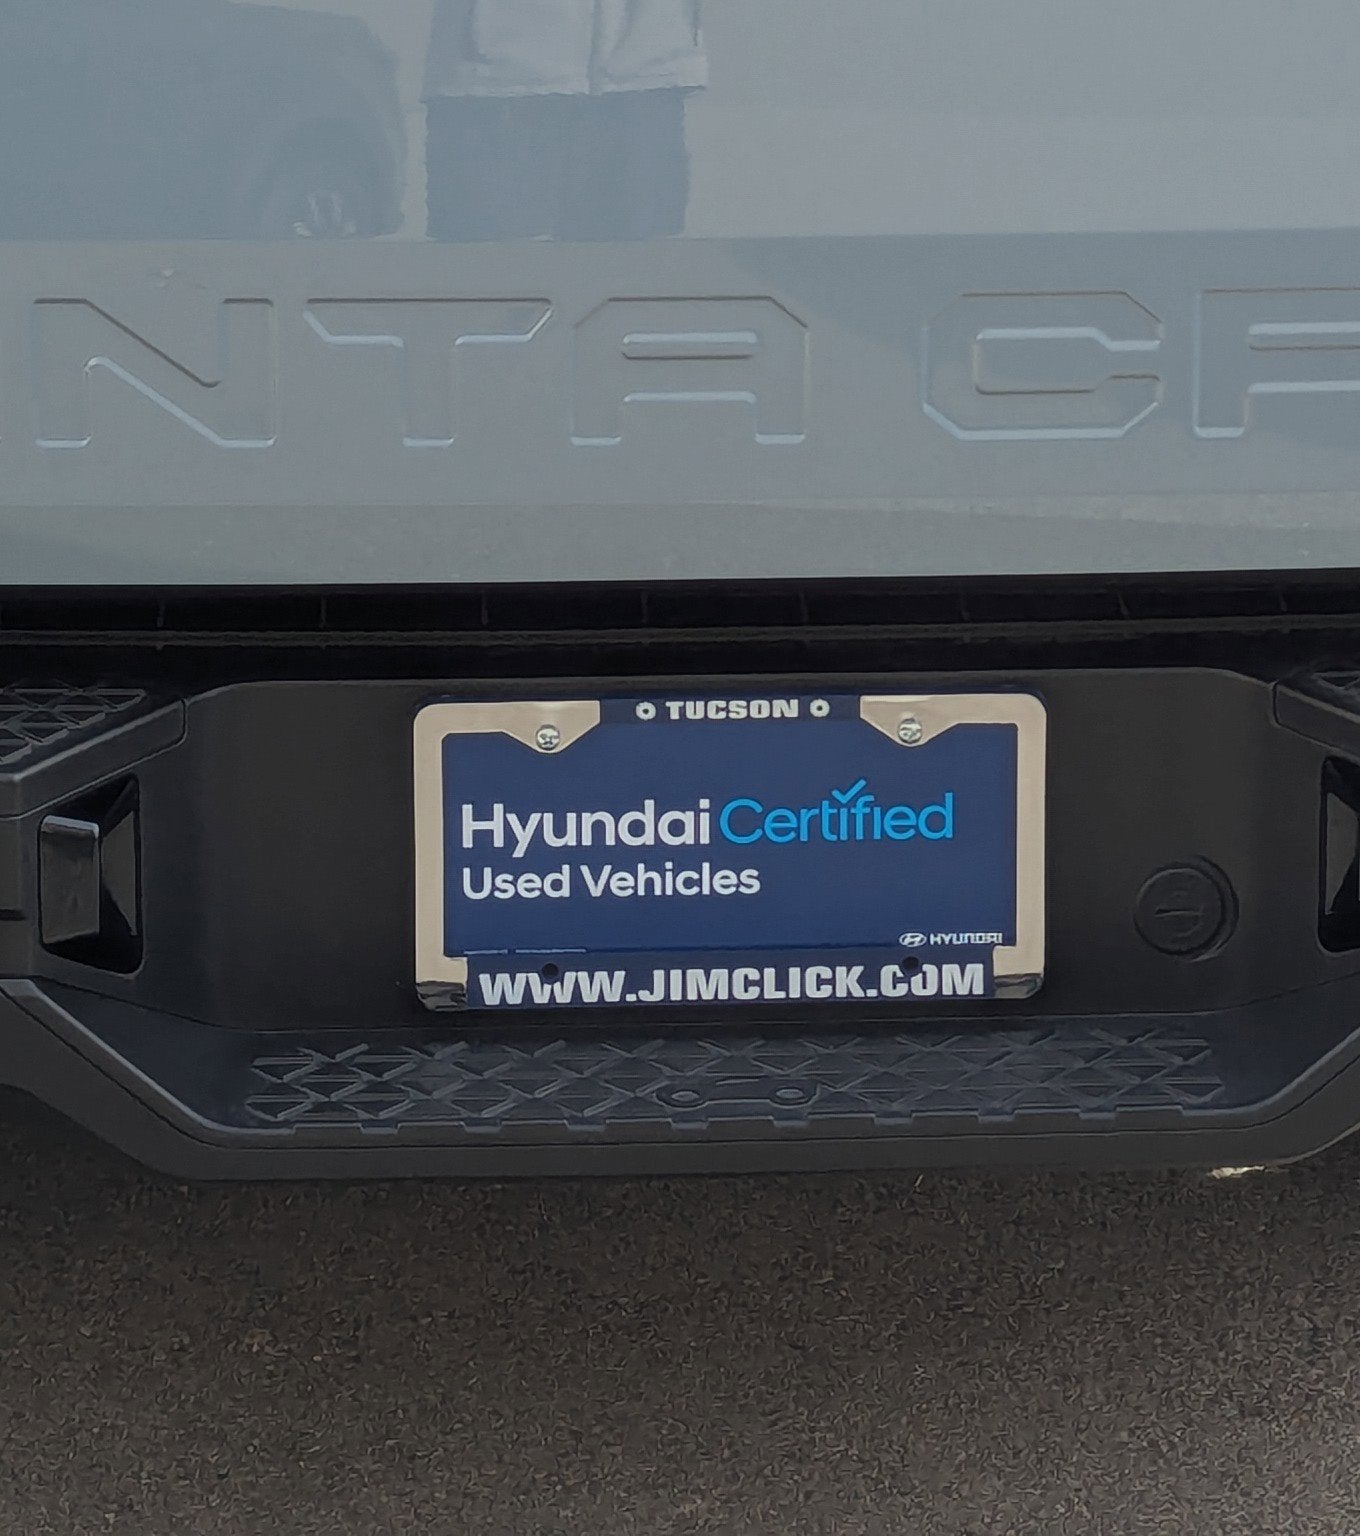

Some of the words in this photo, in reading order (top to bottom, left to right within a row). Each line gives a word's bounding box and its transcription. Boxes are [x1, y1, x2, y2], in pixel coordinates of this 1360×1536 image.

[665, 699, 799, 720] TUCSON
[461, 798, 711, 858] Hyundai
[719, 779, 954, 844] Certified
[462, 865, 571, 900] Used
[580, 862, 761, 898] Vehicles
[929, 933, 1003, 946] HYUNDAI
[478, 962, 985, 1007] WWW.JIMCLICK.COM
